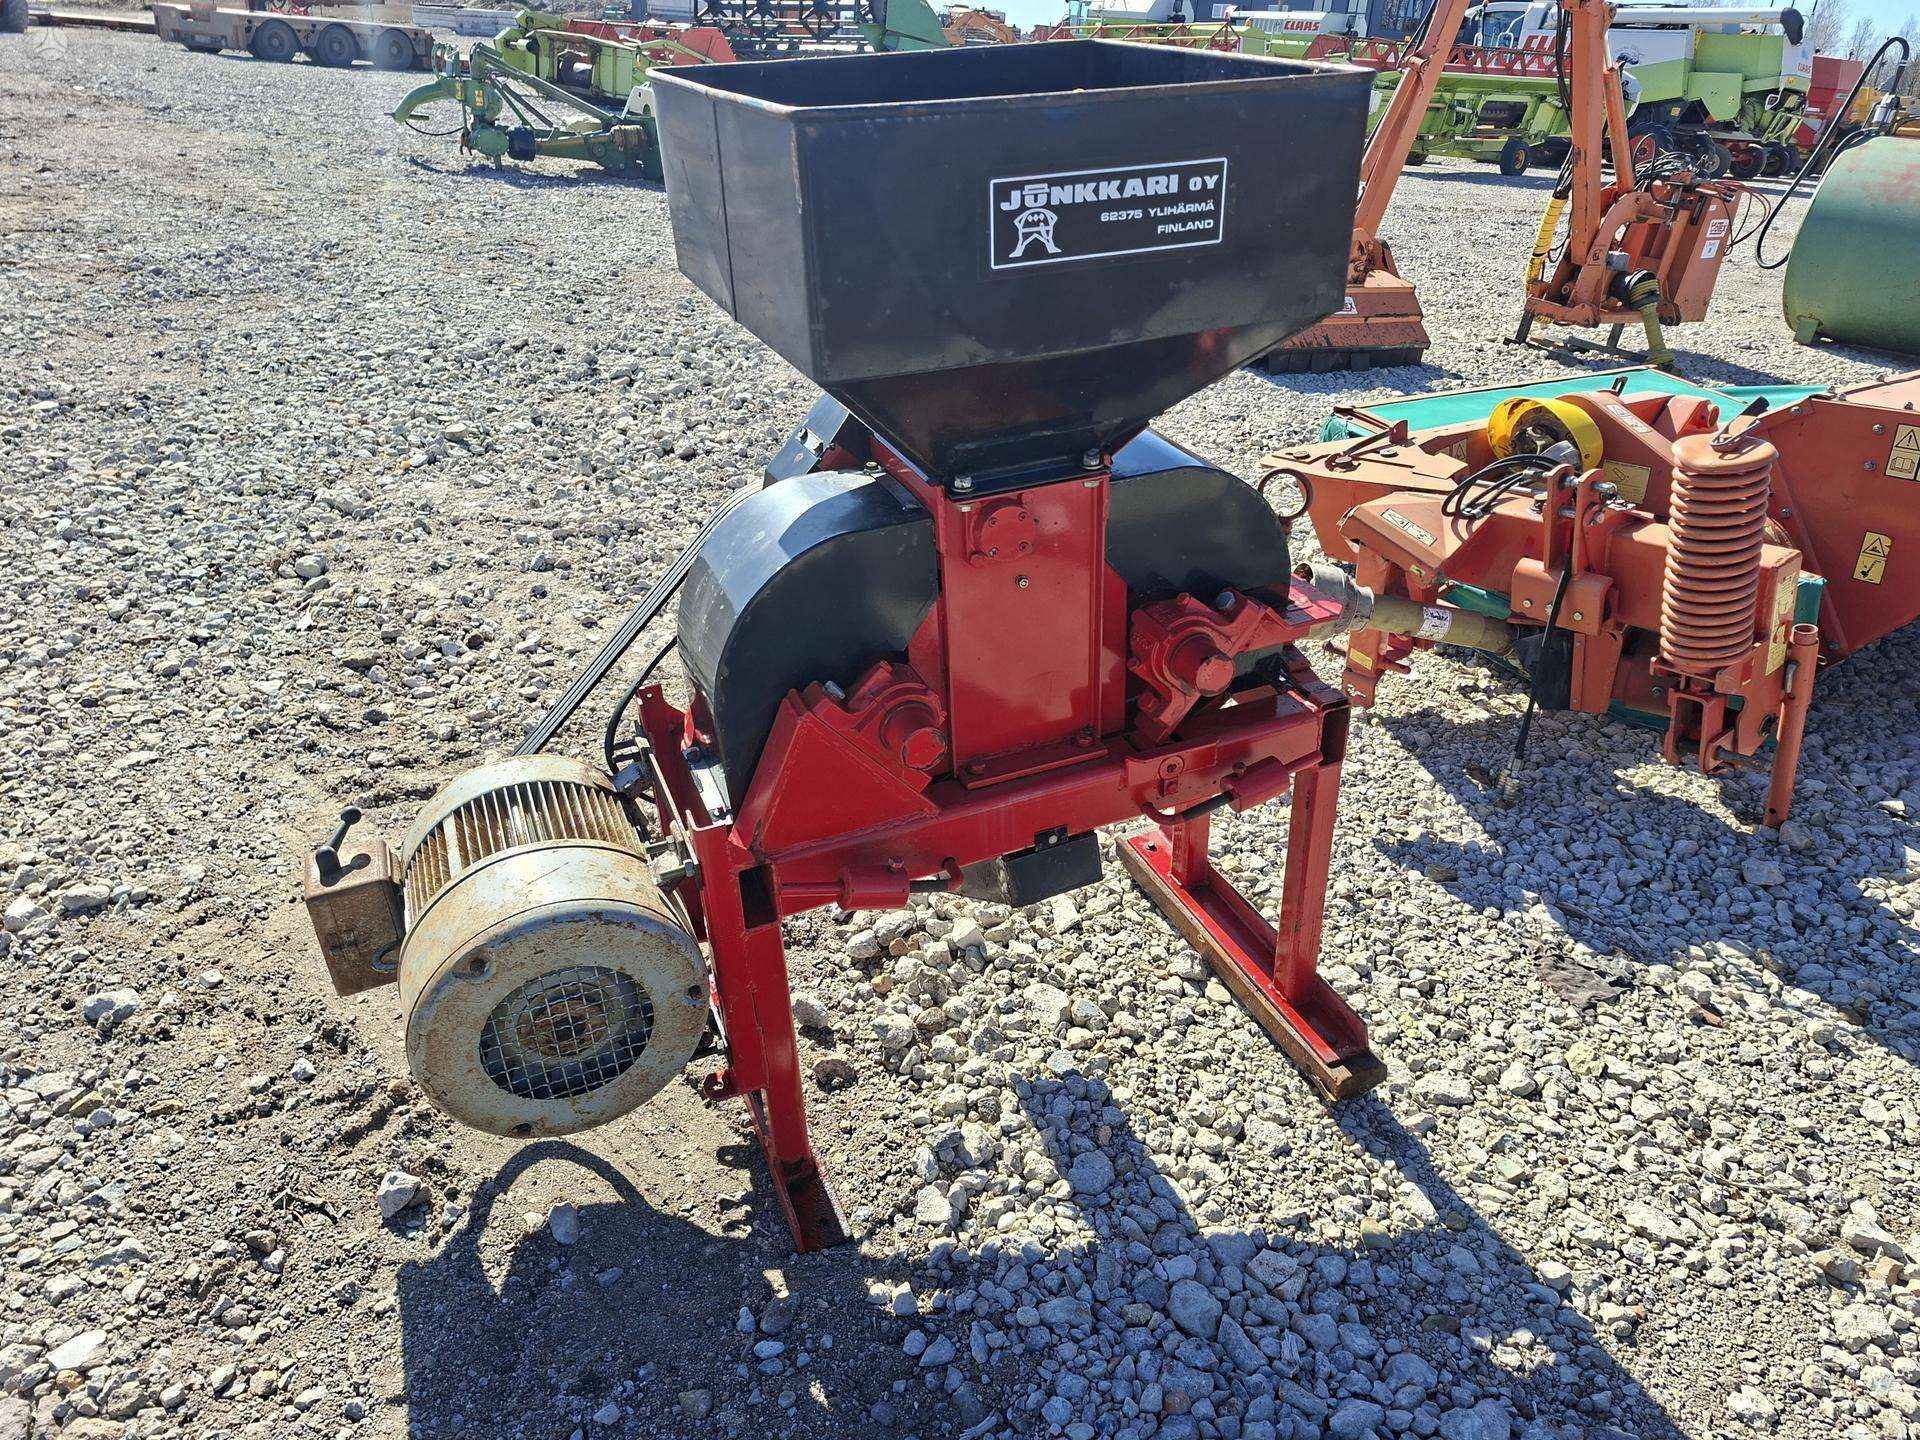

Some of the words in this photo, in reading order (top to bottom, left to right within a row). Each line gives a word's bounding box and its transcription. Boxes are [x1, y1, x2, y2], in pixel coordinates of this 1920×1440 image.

[1284, 20, 1320, 31] CLAAS
[1189, 174, 1219, 191] OY
[1101, 209, 1143, 222] 62375
[1148, 199, 1215, 217] YLIHÄRMÄ
[1157, 219, 1213, 234] FINLAND
